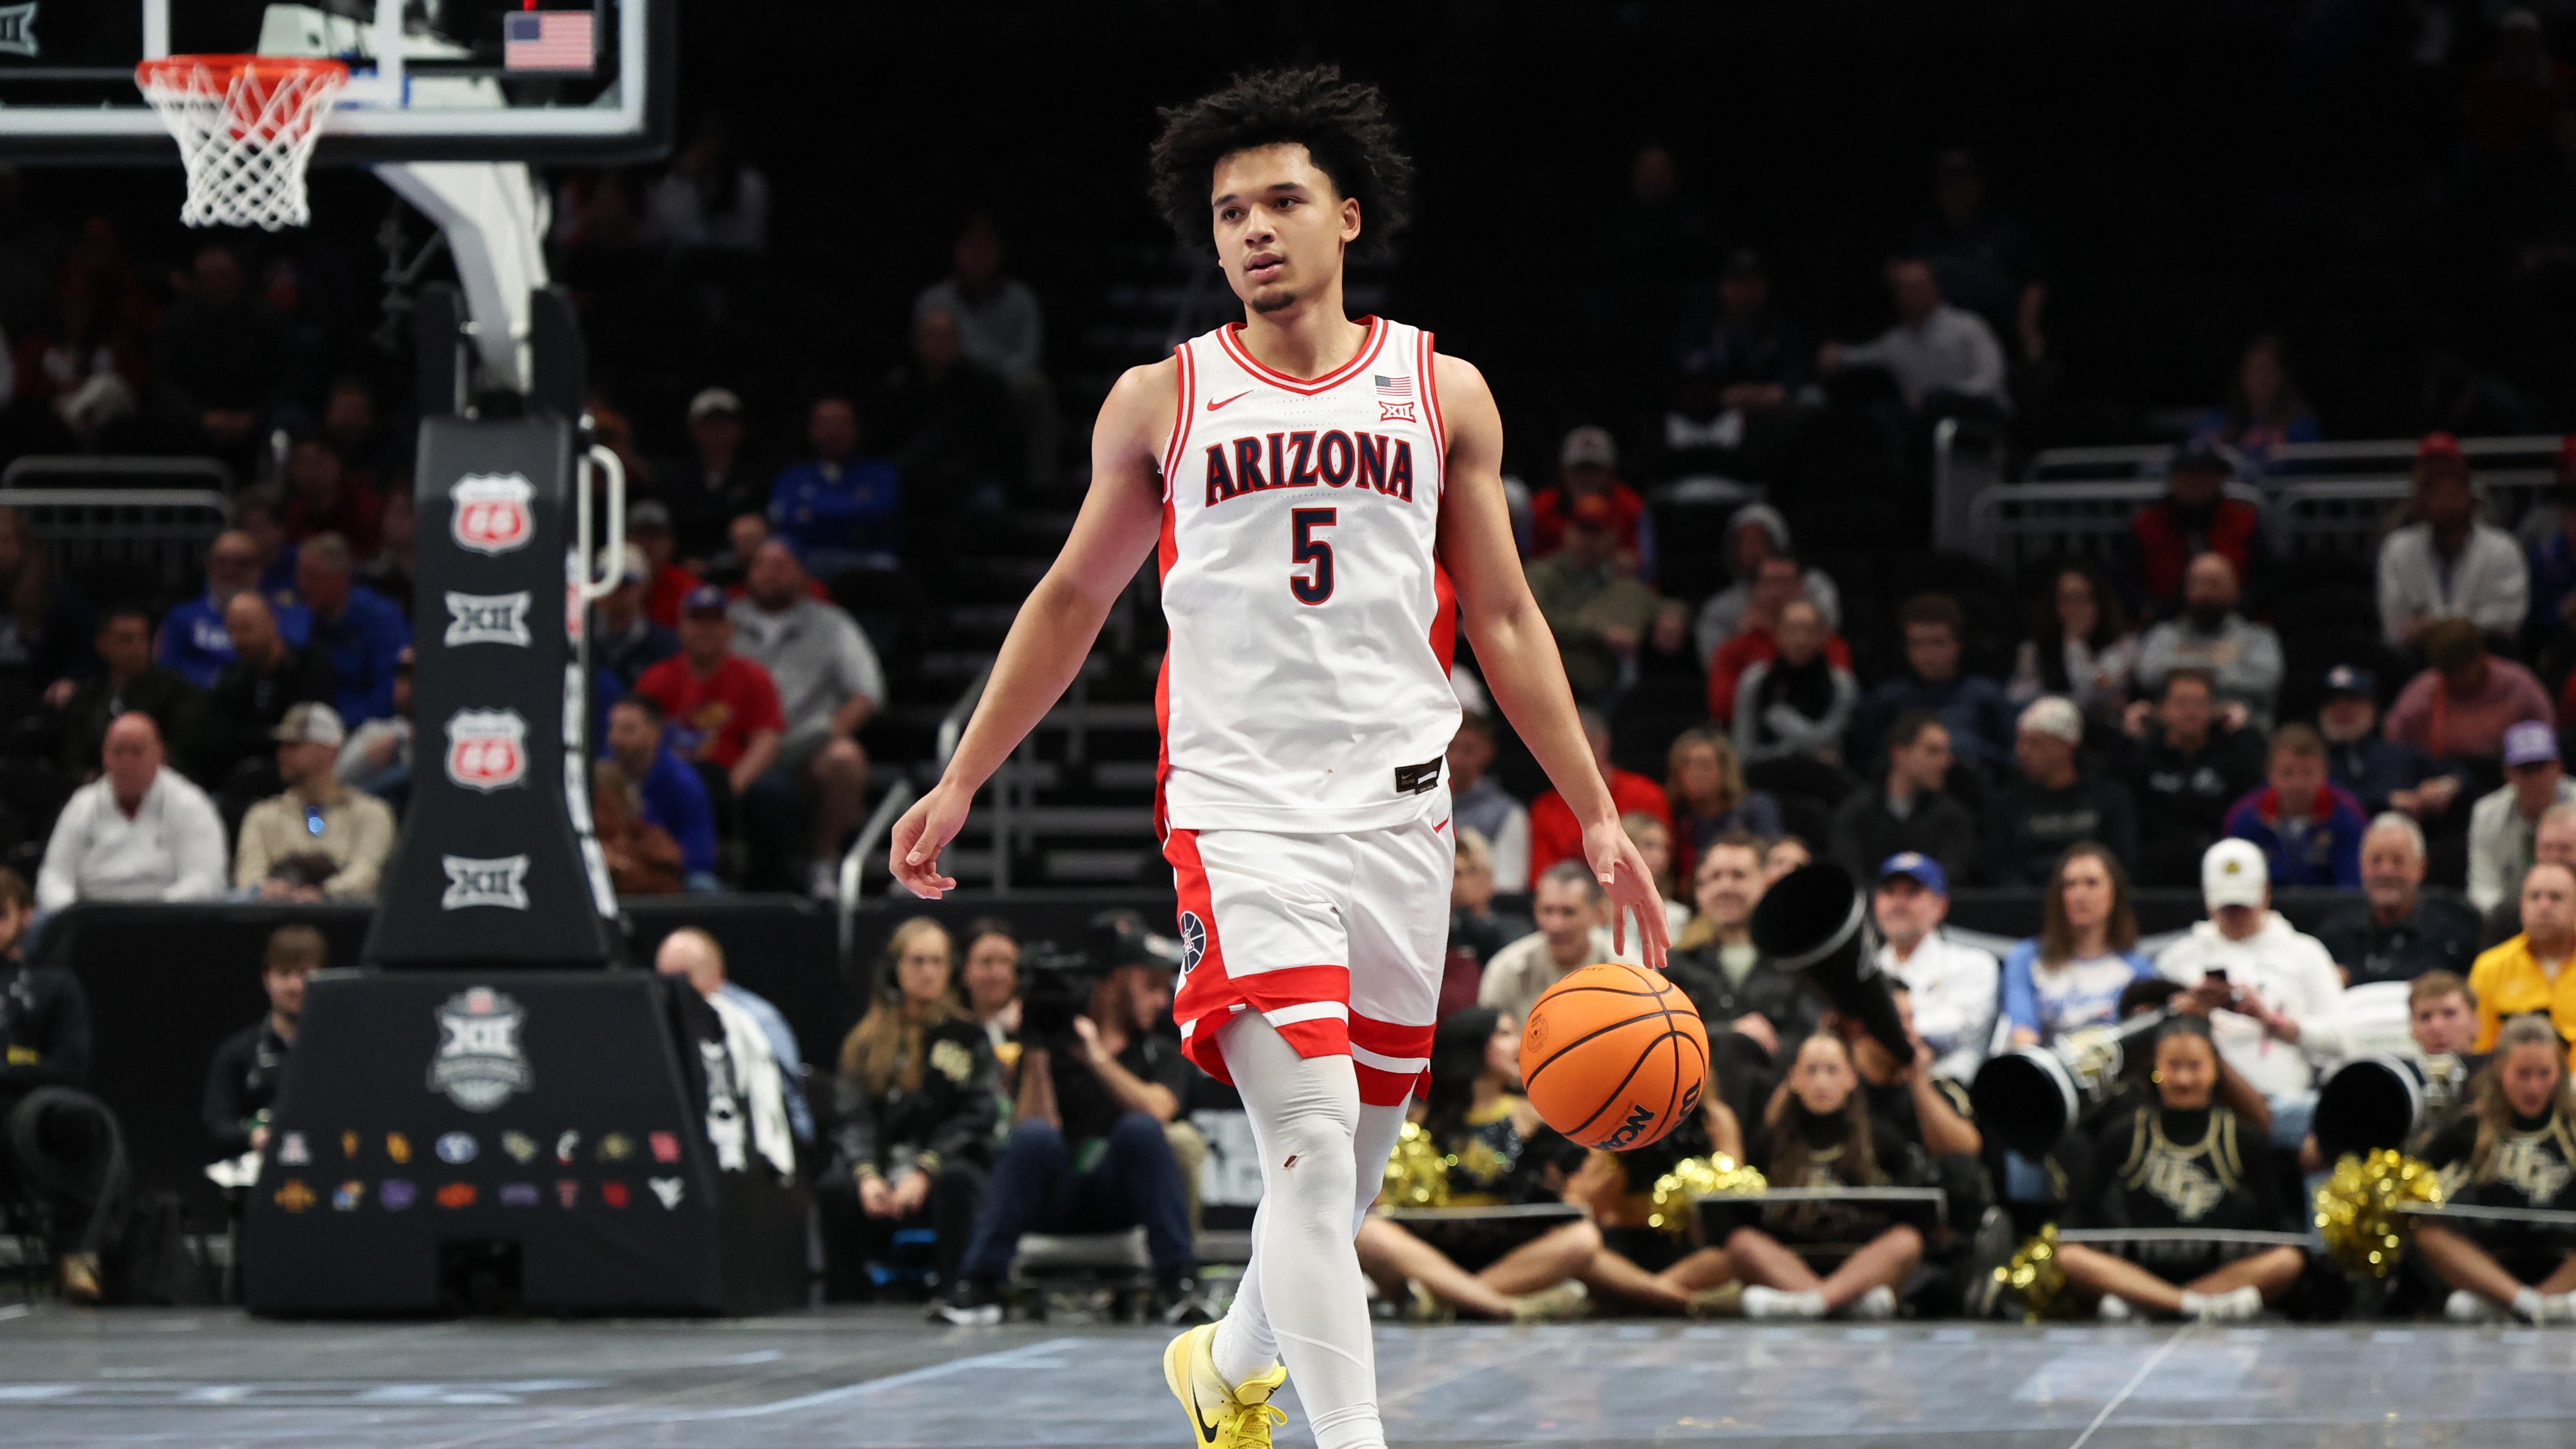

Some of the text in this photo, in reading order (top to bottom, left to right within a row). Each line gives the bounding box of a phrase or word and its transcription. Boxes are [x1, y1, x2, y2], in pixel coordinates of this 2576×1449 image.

[1379, 401, 1416, 423] XII
[1206, 430, 1412, 507] ARIZONA
[466, 504, 515, 536] 66
[1290, 507, 1337, 605] 5
[461, 739, 509, 772] 66
